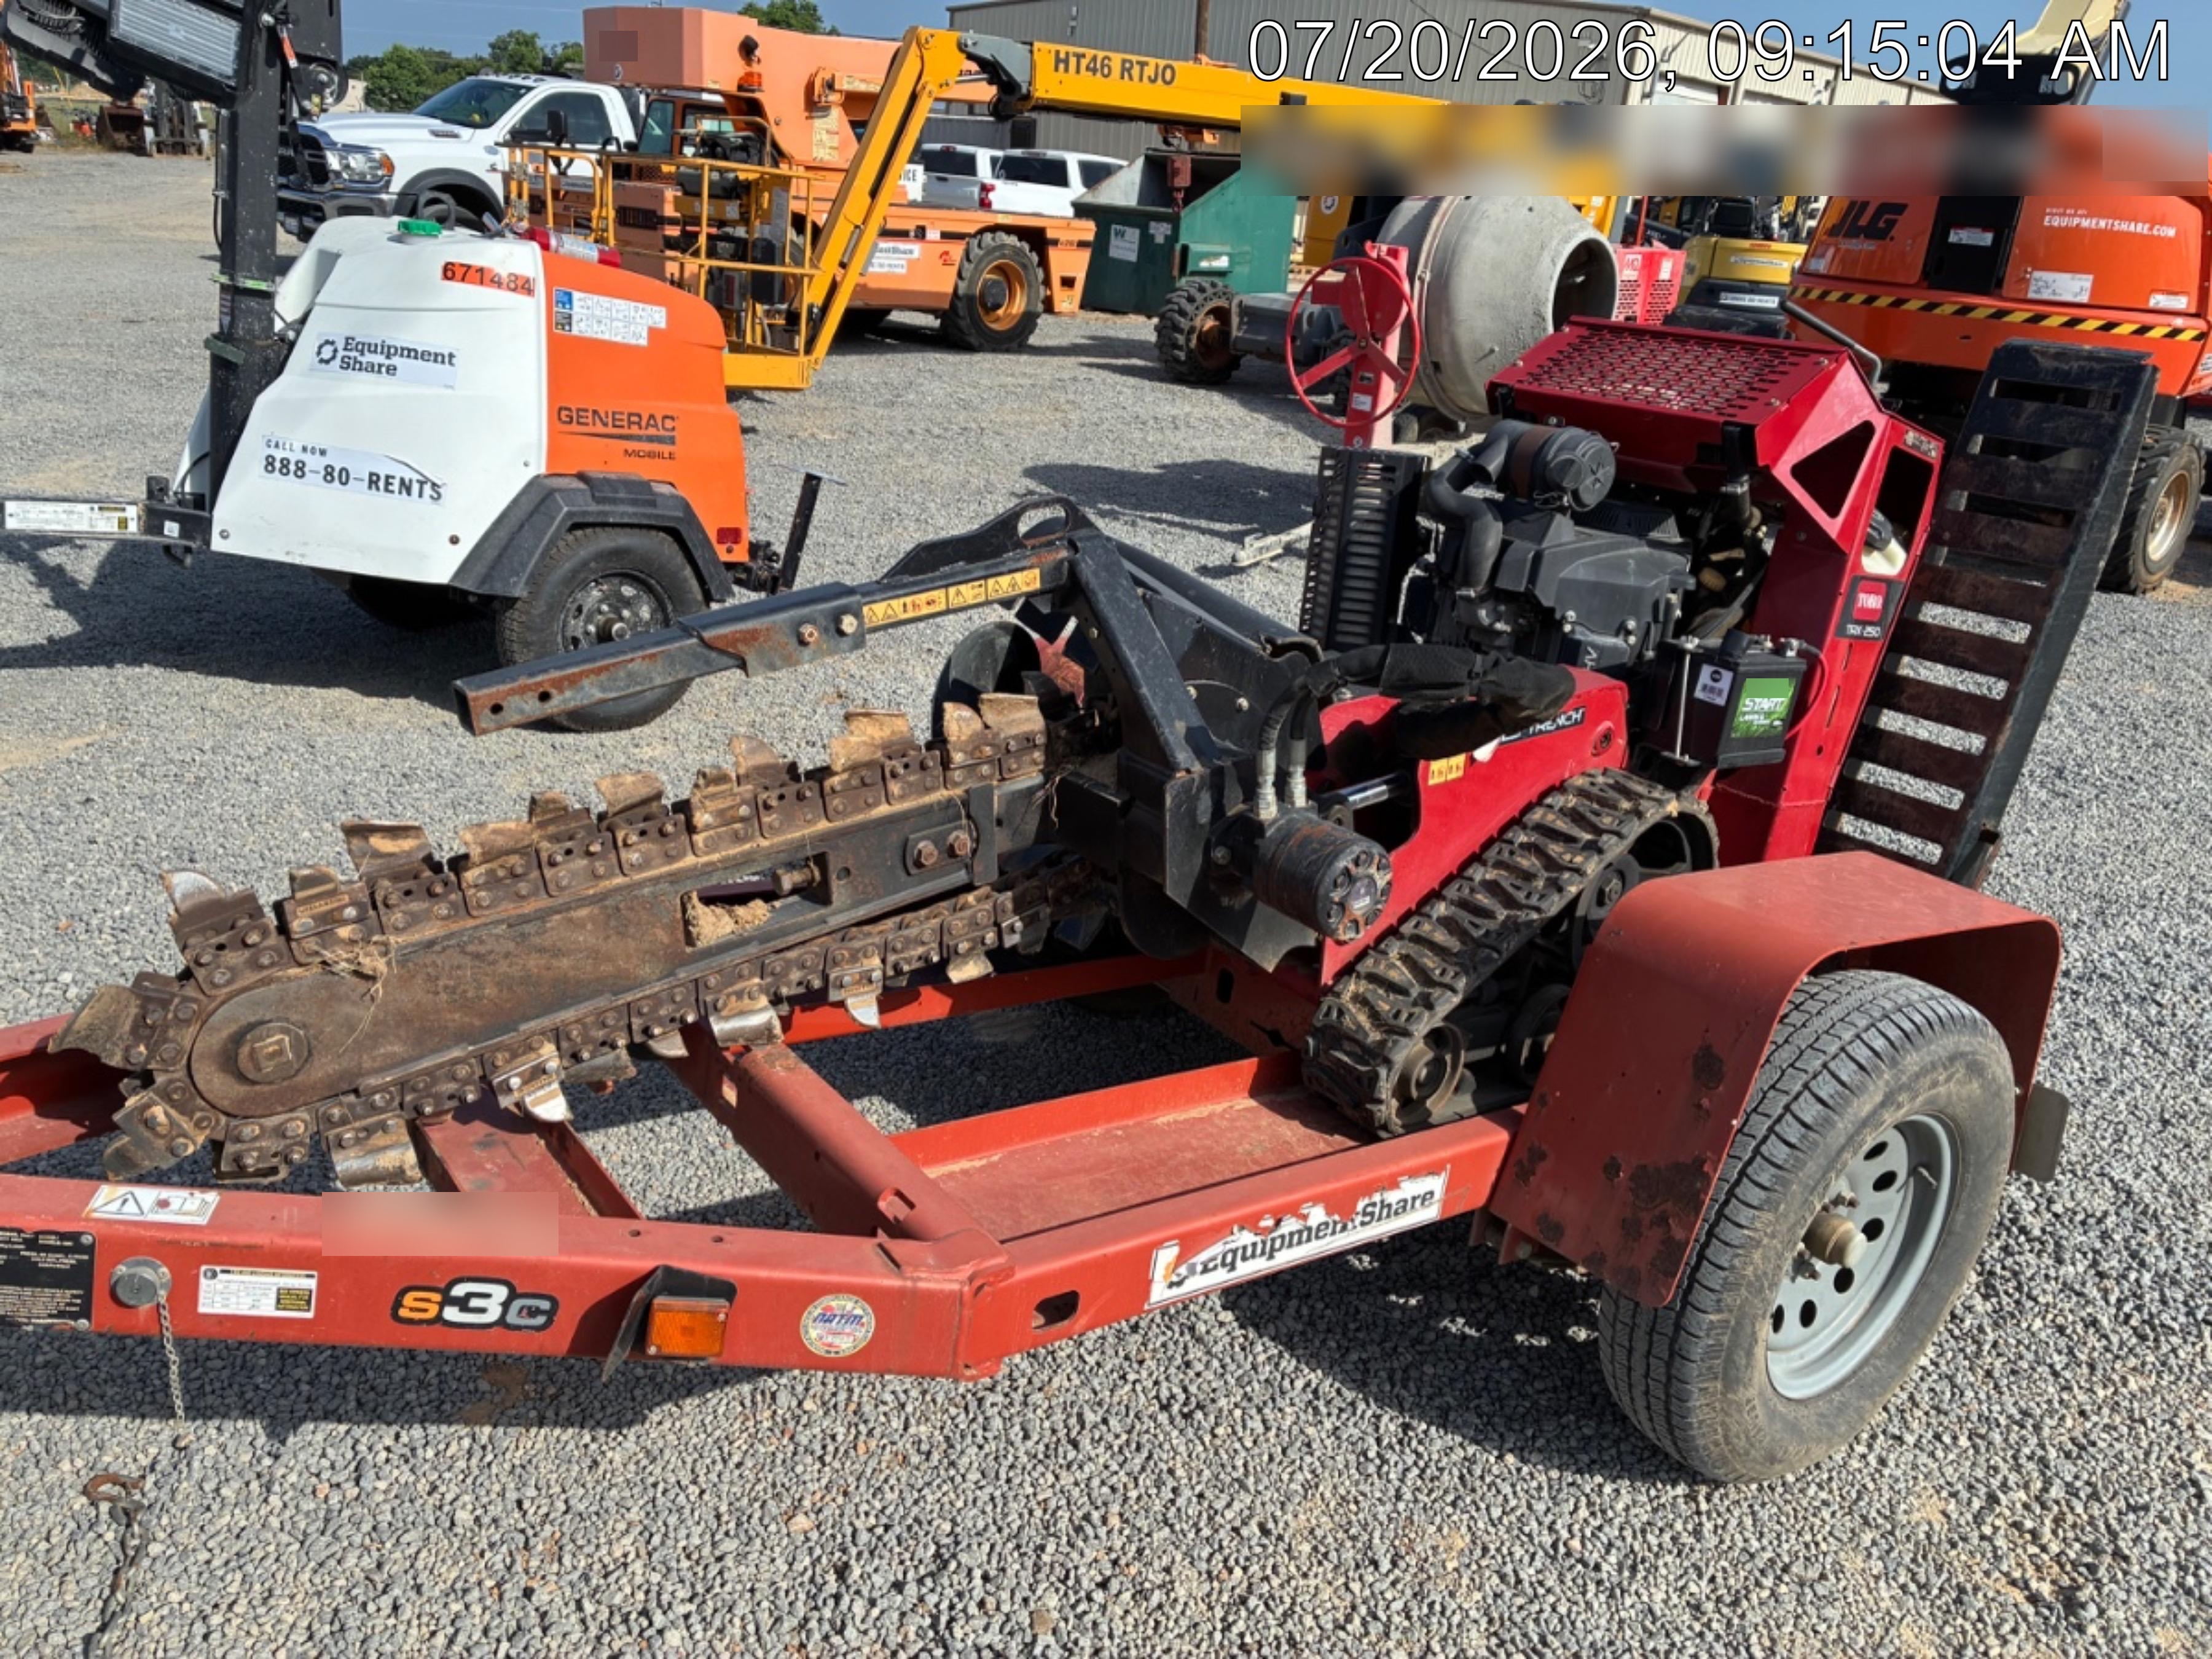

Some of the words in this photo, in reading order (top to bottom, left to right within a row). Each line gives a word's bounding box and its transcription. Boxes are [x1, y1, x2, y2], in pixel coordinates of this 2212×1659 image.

[1054, 49, 1112, 78] HT46
[1120, 58, 1176, 85] RTJO
[1829, 200, 1908, 241] JLG
[2044, 215, 2176, 237] EQUIPMENTSHARE.COM
[442, 262, 533, 295] 671484
[342, 337, 456, 367] Equipment
[339, 356, 397, 376] Share
[558, 406, 675, 431] GENERAC
[265, 439, 296, 453] CALL
[302, 444, 327, 458] NOW
[624, 449, 675, 460] MOBILE
[264, 454, 442, 501] 888-80-RENTS
